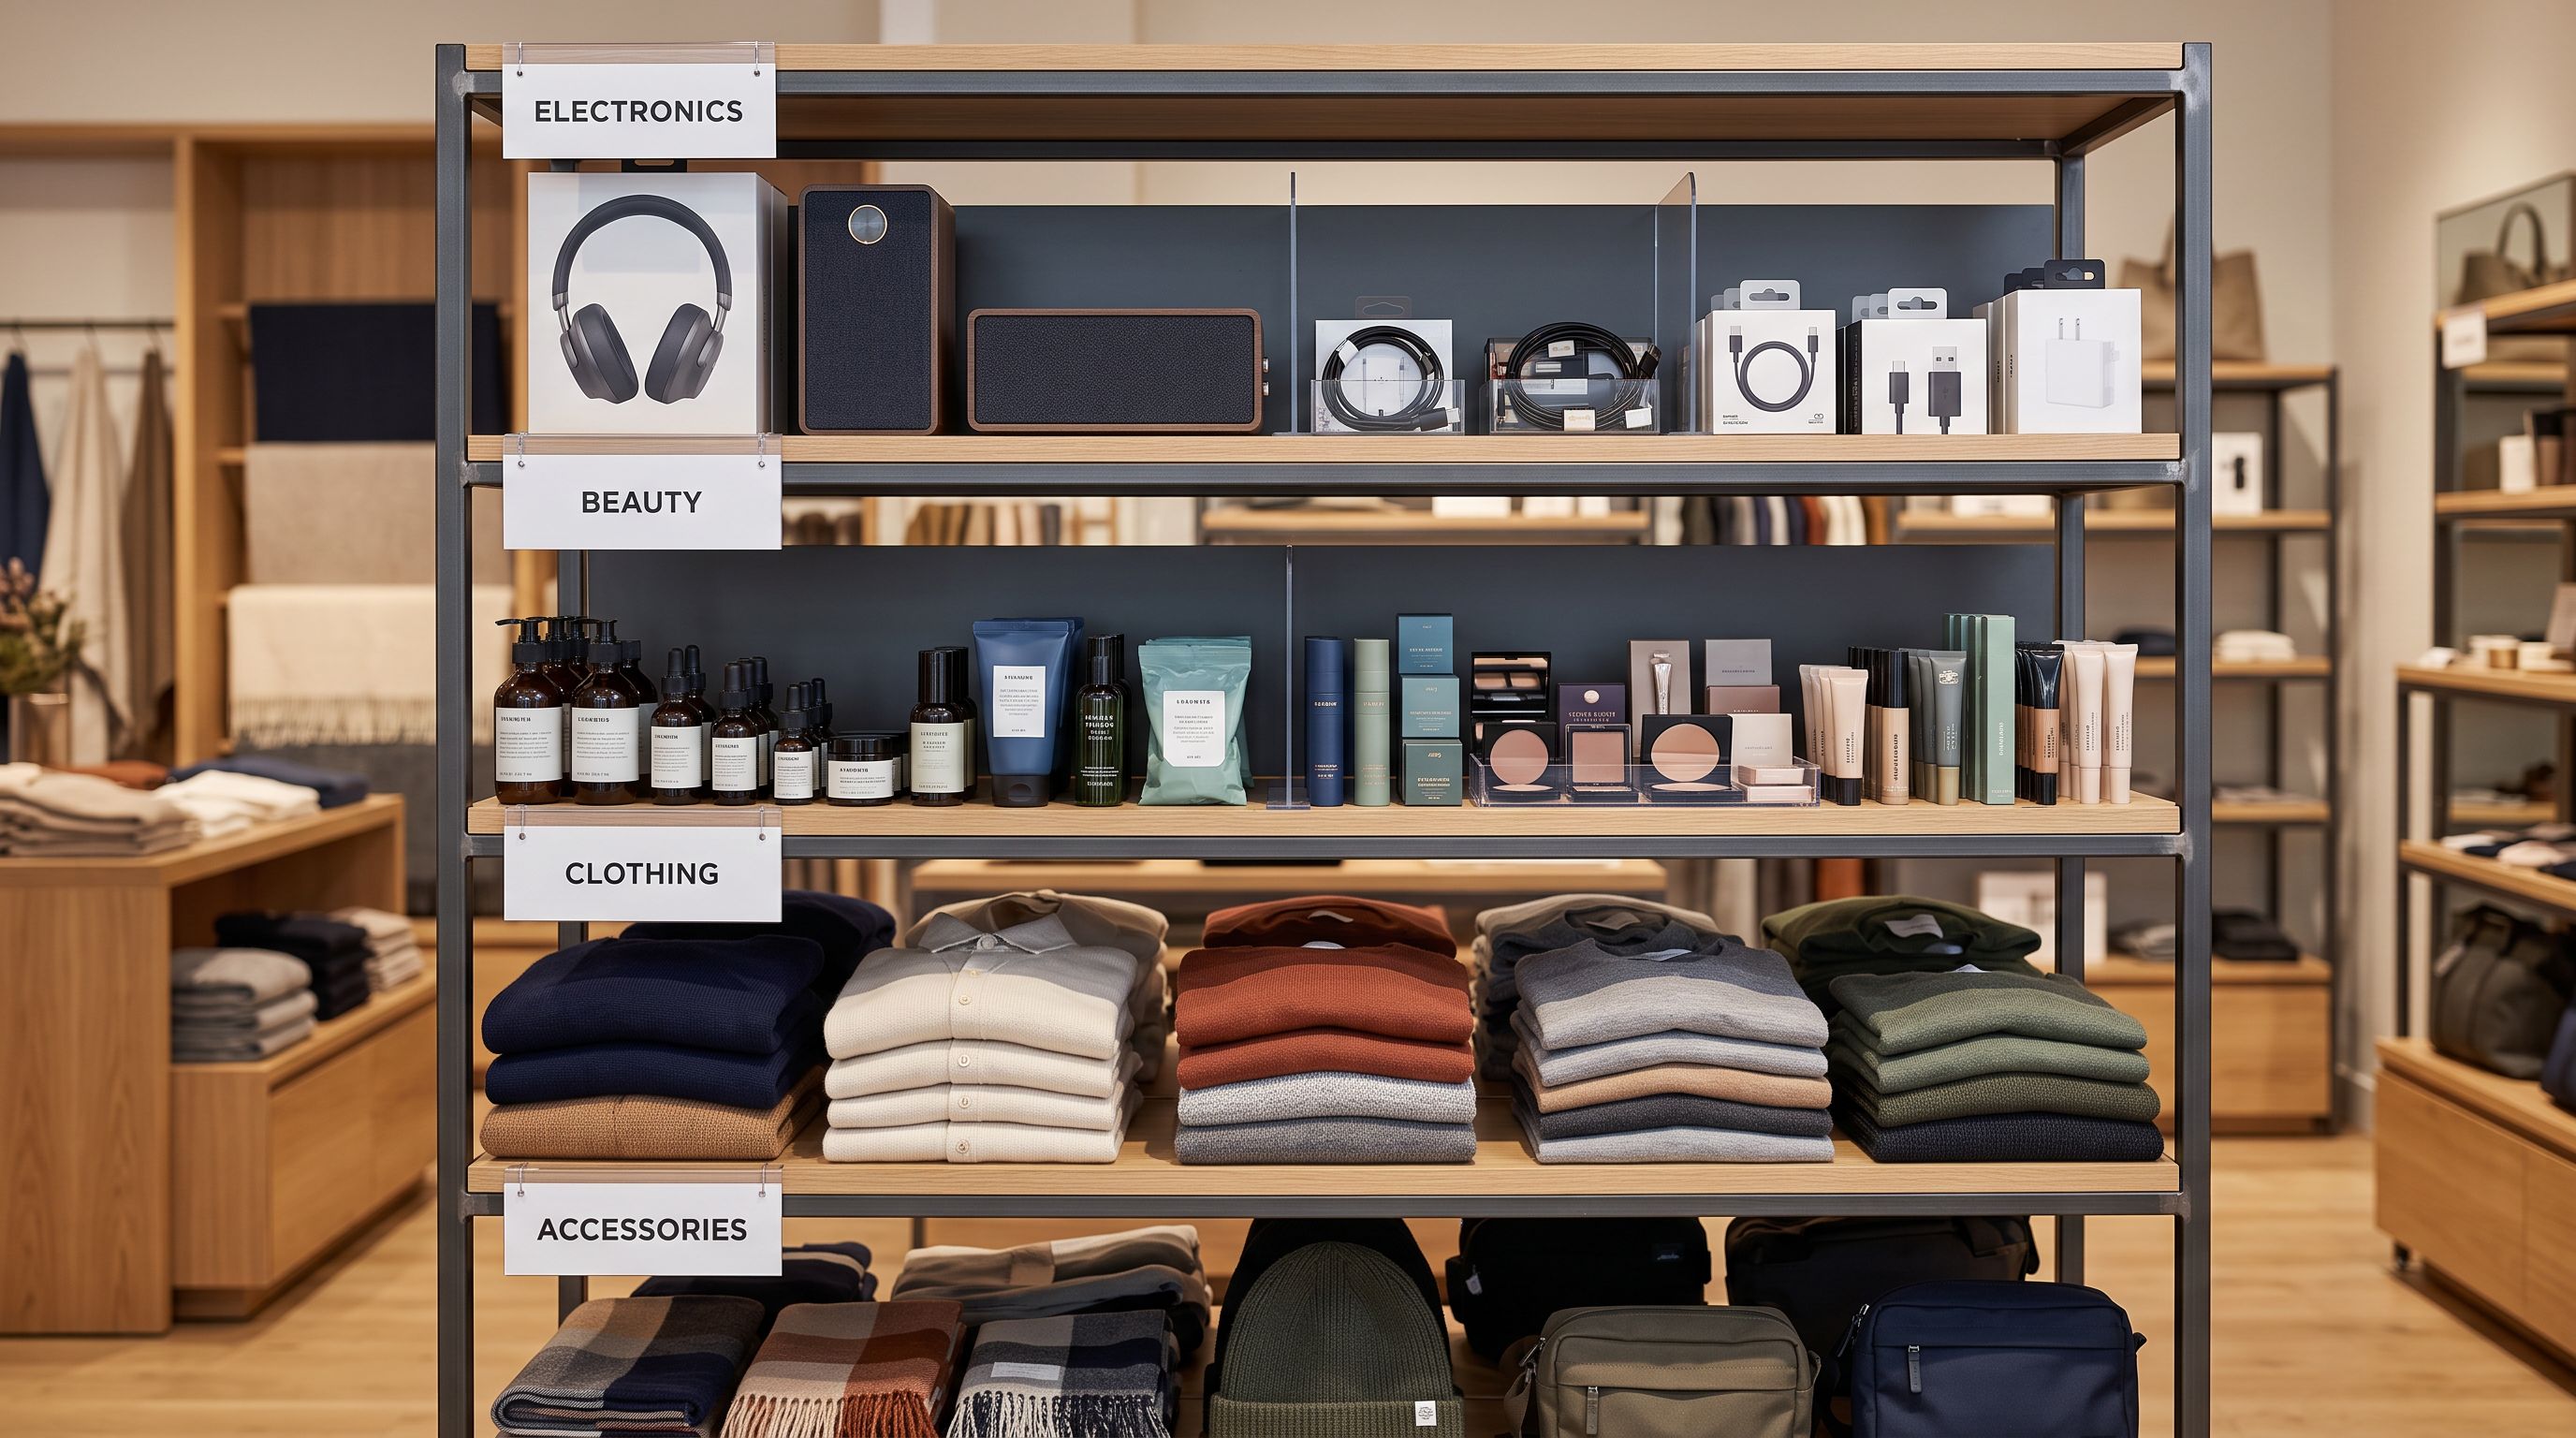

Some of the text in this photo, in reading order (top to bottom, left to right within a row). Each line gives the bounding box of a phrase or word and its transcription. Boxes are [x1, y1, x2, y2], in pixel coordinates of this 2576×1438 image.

[534, 99, 743, 123] ELECTRONICS
[582, 491, 703, 514] BEAUTY
[565, 861, 719, 886] CLOTHING
[536, 1217, 747, 1241] ACCESSORIES
